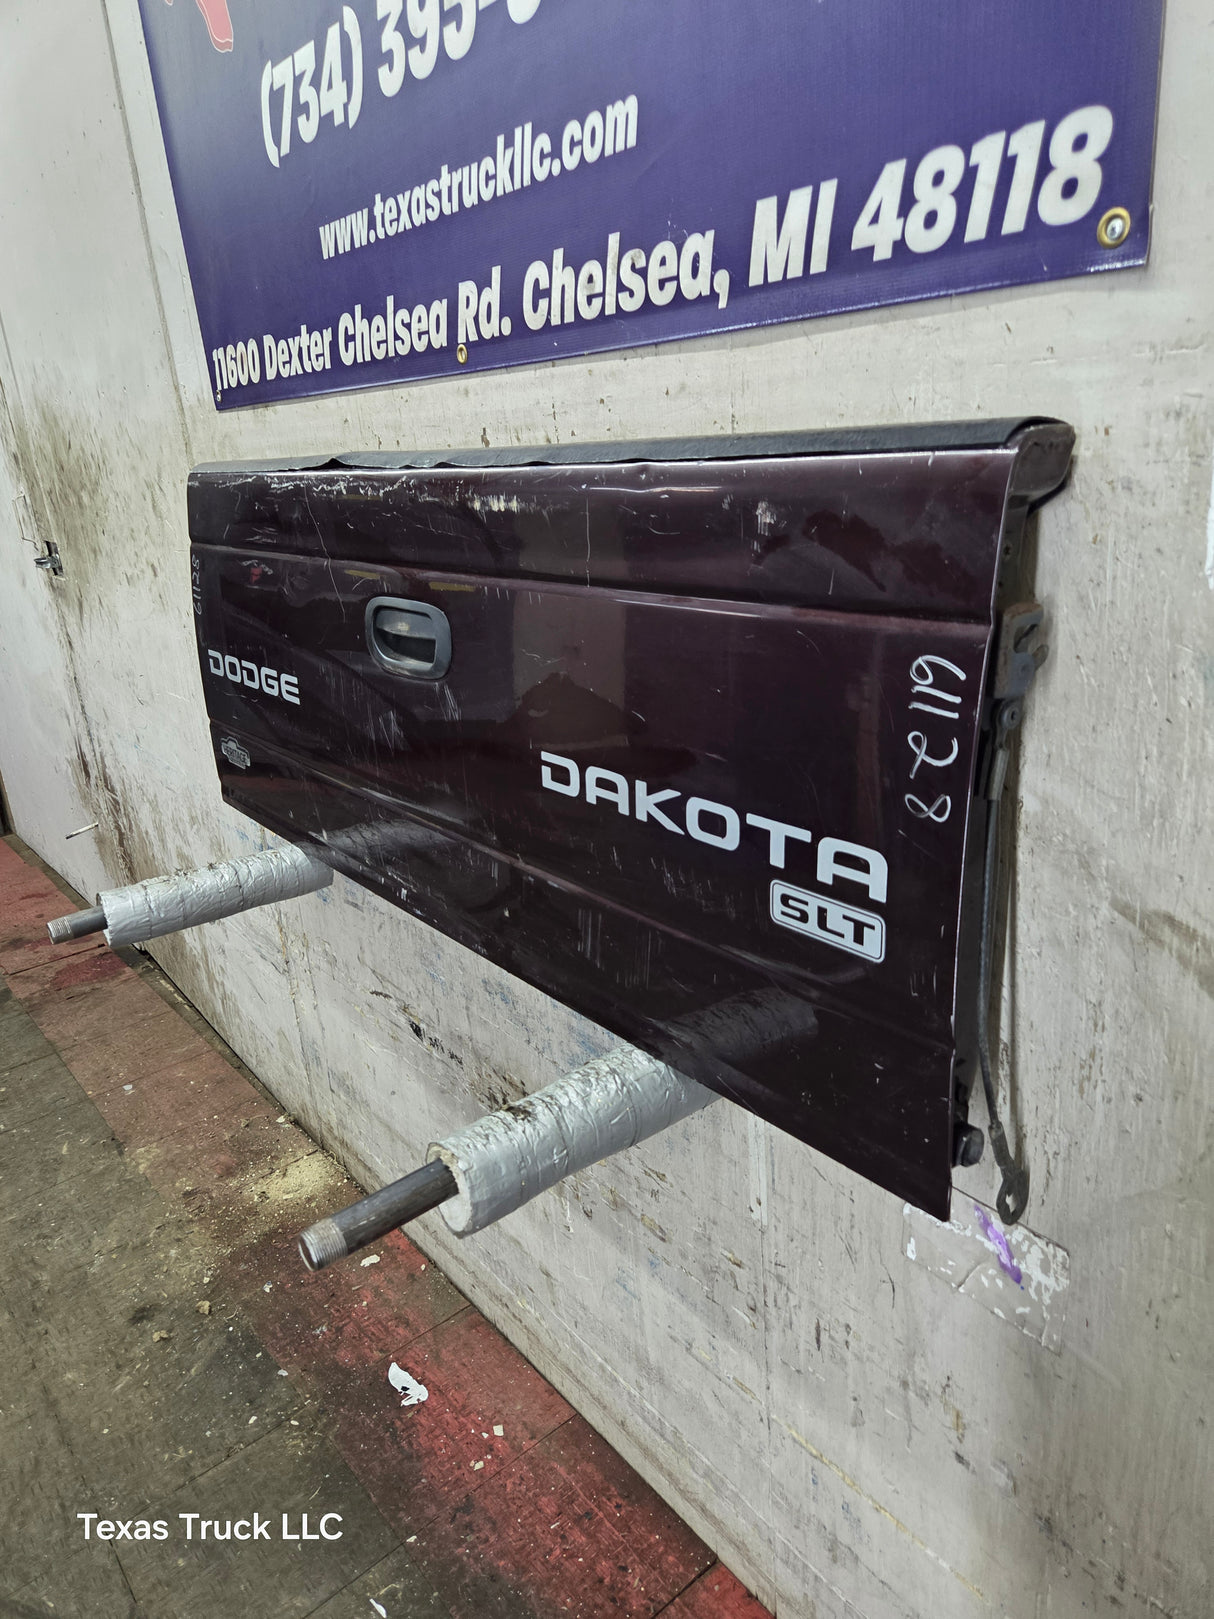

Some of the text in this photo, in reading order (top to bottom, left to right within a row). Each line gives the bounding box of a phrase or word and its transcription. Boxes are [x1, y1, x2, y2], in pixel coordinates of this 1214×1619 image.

[261, 5, 363, 168] (734)
[212, 104, 1113, 391] 11600 Dexter Chelsea Rd. Chelsea, MI 48118
[319, 94, 638, 260] www.texastruckllc.com
[208, 649, 301, 706] DODGE
[540, 750, 888, 903] DAKOTA
[779, 892, 876, 948] SLT
